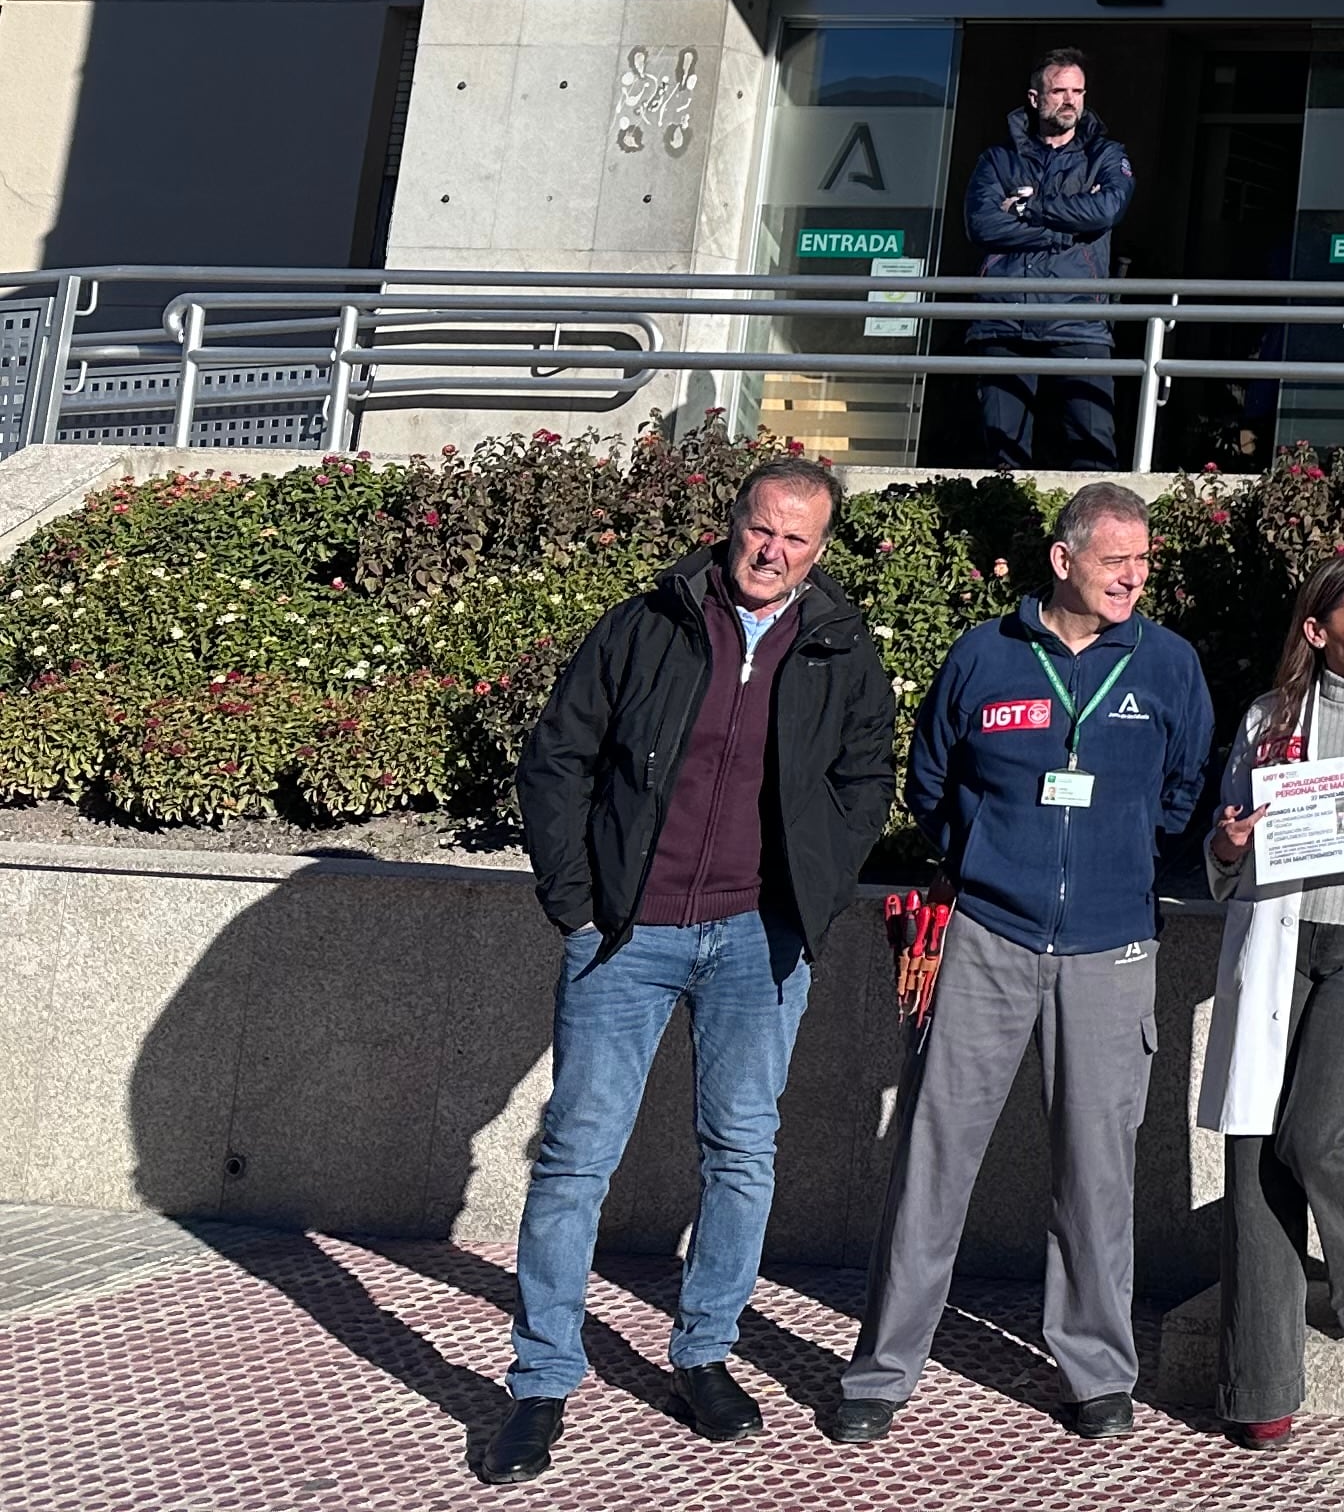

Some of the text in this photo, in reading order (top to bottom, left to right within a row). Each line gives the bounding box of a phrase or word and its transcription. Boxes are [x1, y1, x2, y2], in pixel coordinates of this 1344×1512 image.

[800, 233, 898, 252] ENTRADA
[983, 705, 1026, 728] UGT
[1276, 786, 1317, 798] PERSONAL
[1319, 784, 1328, 792] DE
